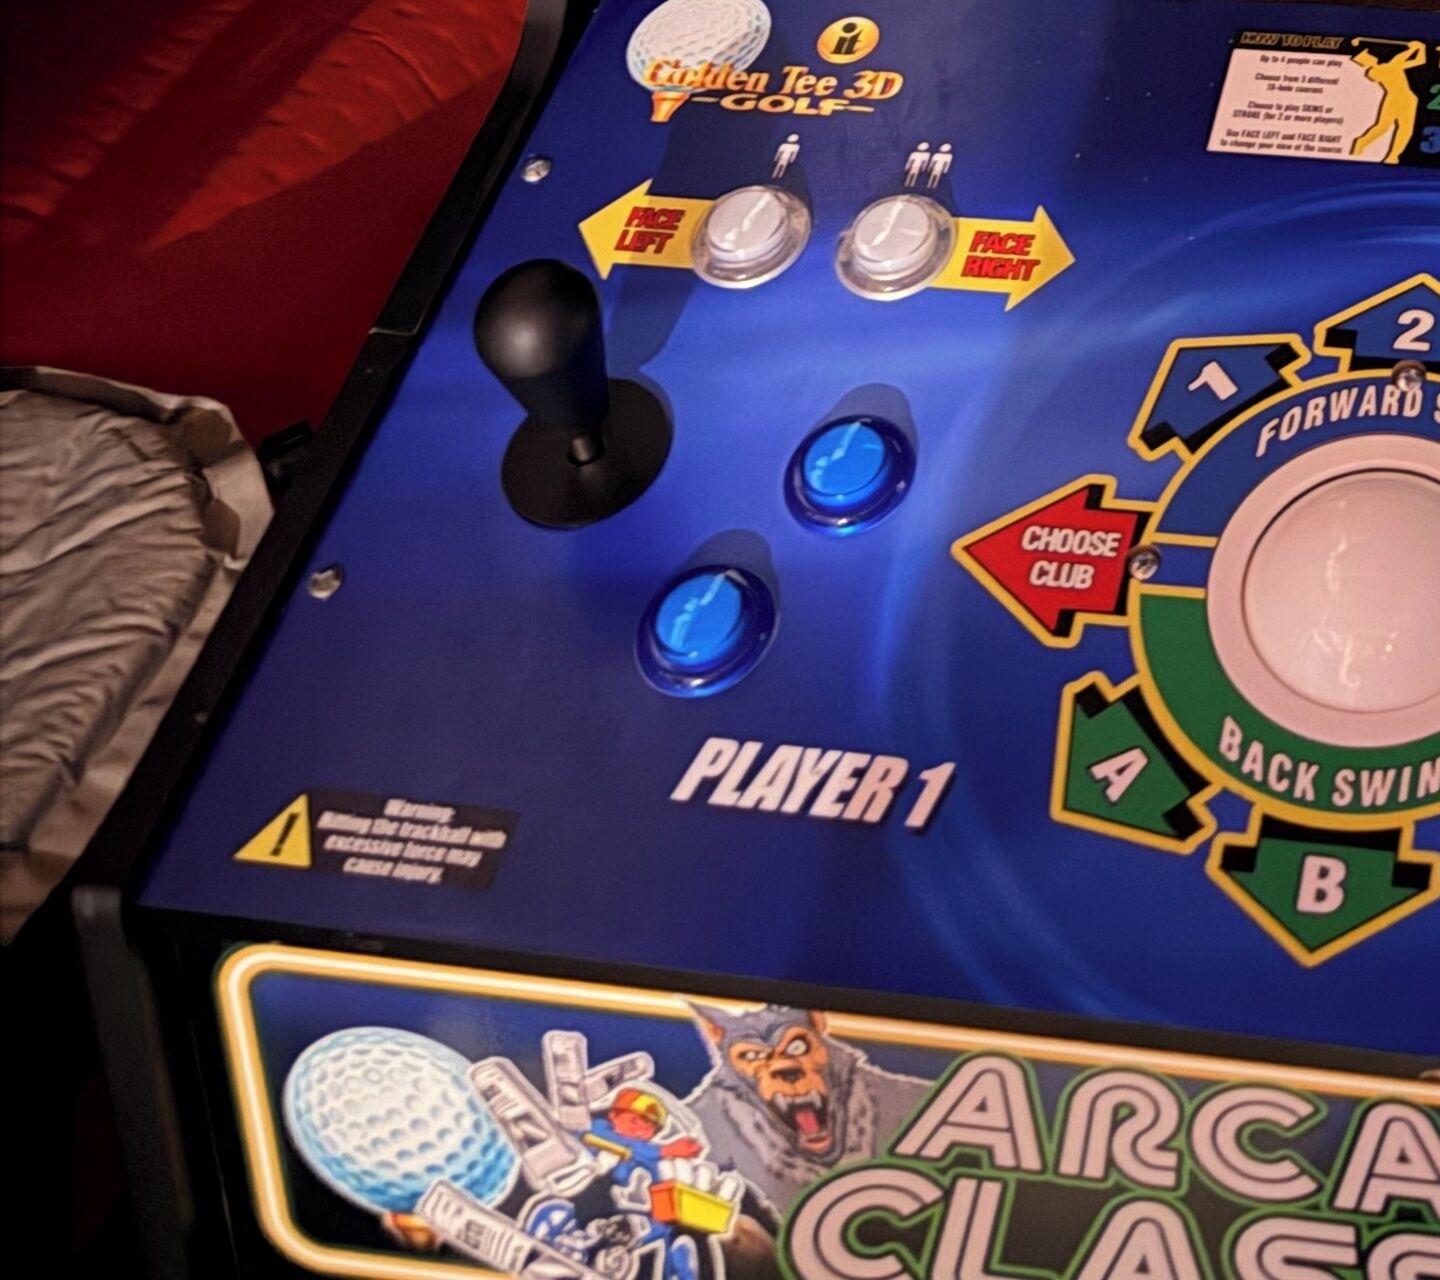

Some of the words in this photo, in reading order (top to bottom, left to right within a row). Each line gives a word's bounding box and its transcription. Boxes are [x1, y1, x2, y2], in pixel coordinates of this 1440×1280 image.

[643, 58, 769, 92] Golden
[782, 65, 838, 96] Tee
[843, 70, 904, 99] 3D
[625, 206, 686, 231] FACE
[613, 230, 675, 254] LEFT
[970, 230, 1036, 256] FACE
[960, 253, 1041, 281] RIGHT
[1393, 307, 1436, 352] 2
[1187, 360, 1239, 401] 1
[1255, 383, 1424, 458] FORWARD
[1020, 524, 1122, 559] CHOOSE
[1028, 558, 1095, 590] CLUB
[1088, 746, 1149, 803] A
[1218, 715, 1320, 802] BACK
[669, 736, 909, 824] PLAYER
[904, 761, 957, 829] 1
[1295, 856, 1347, 915] B
